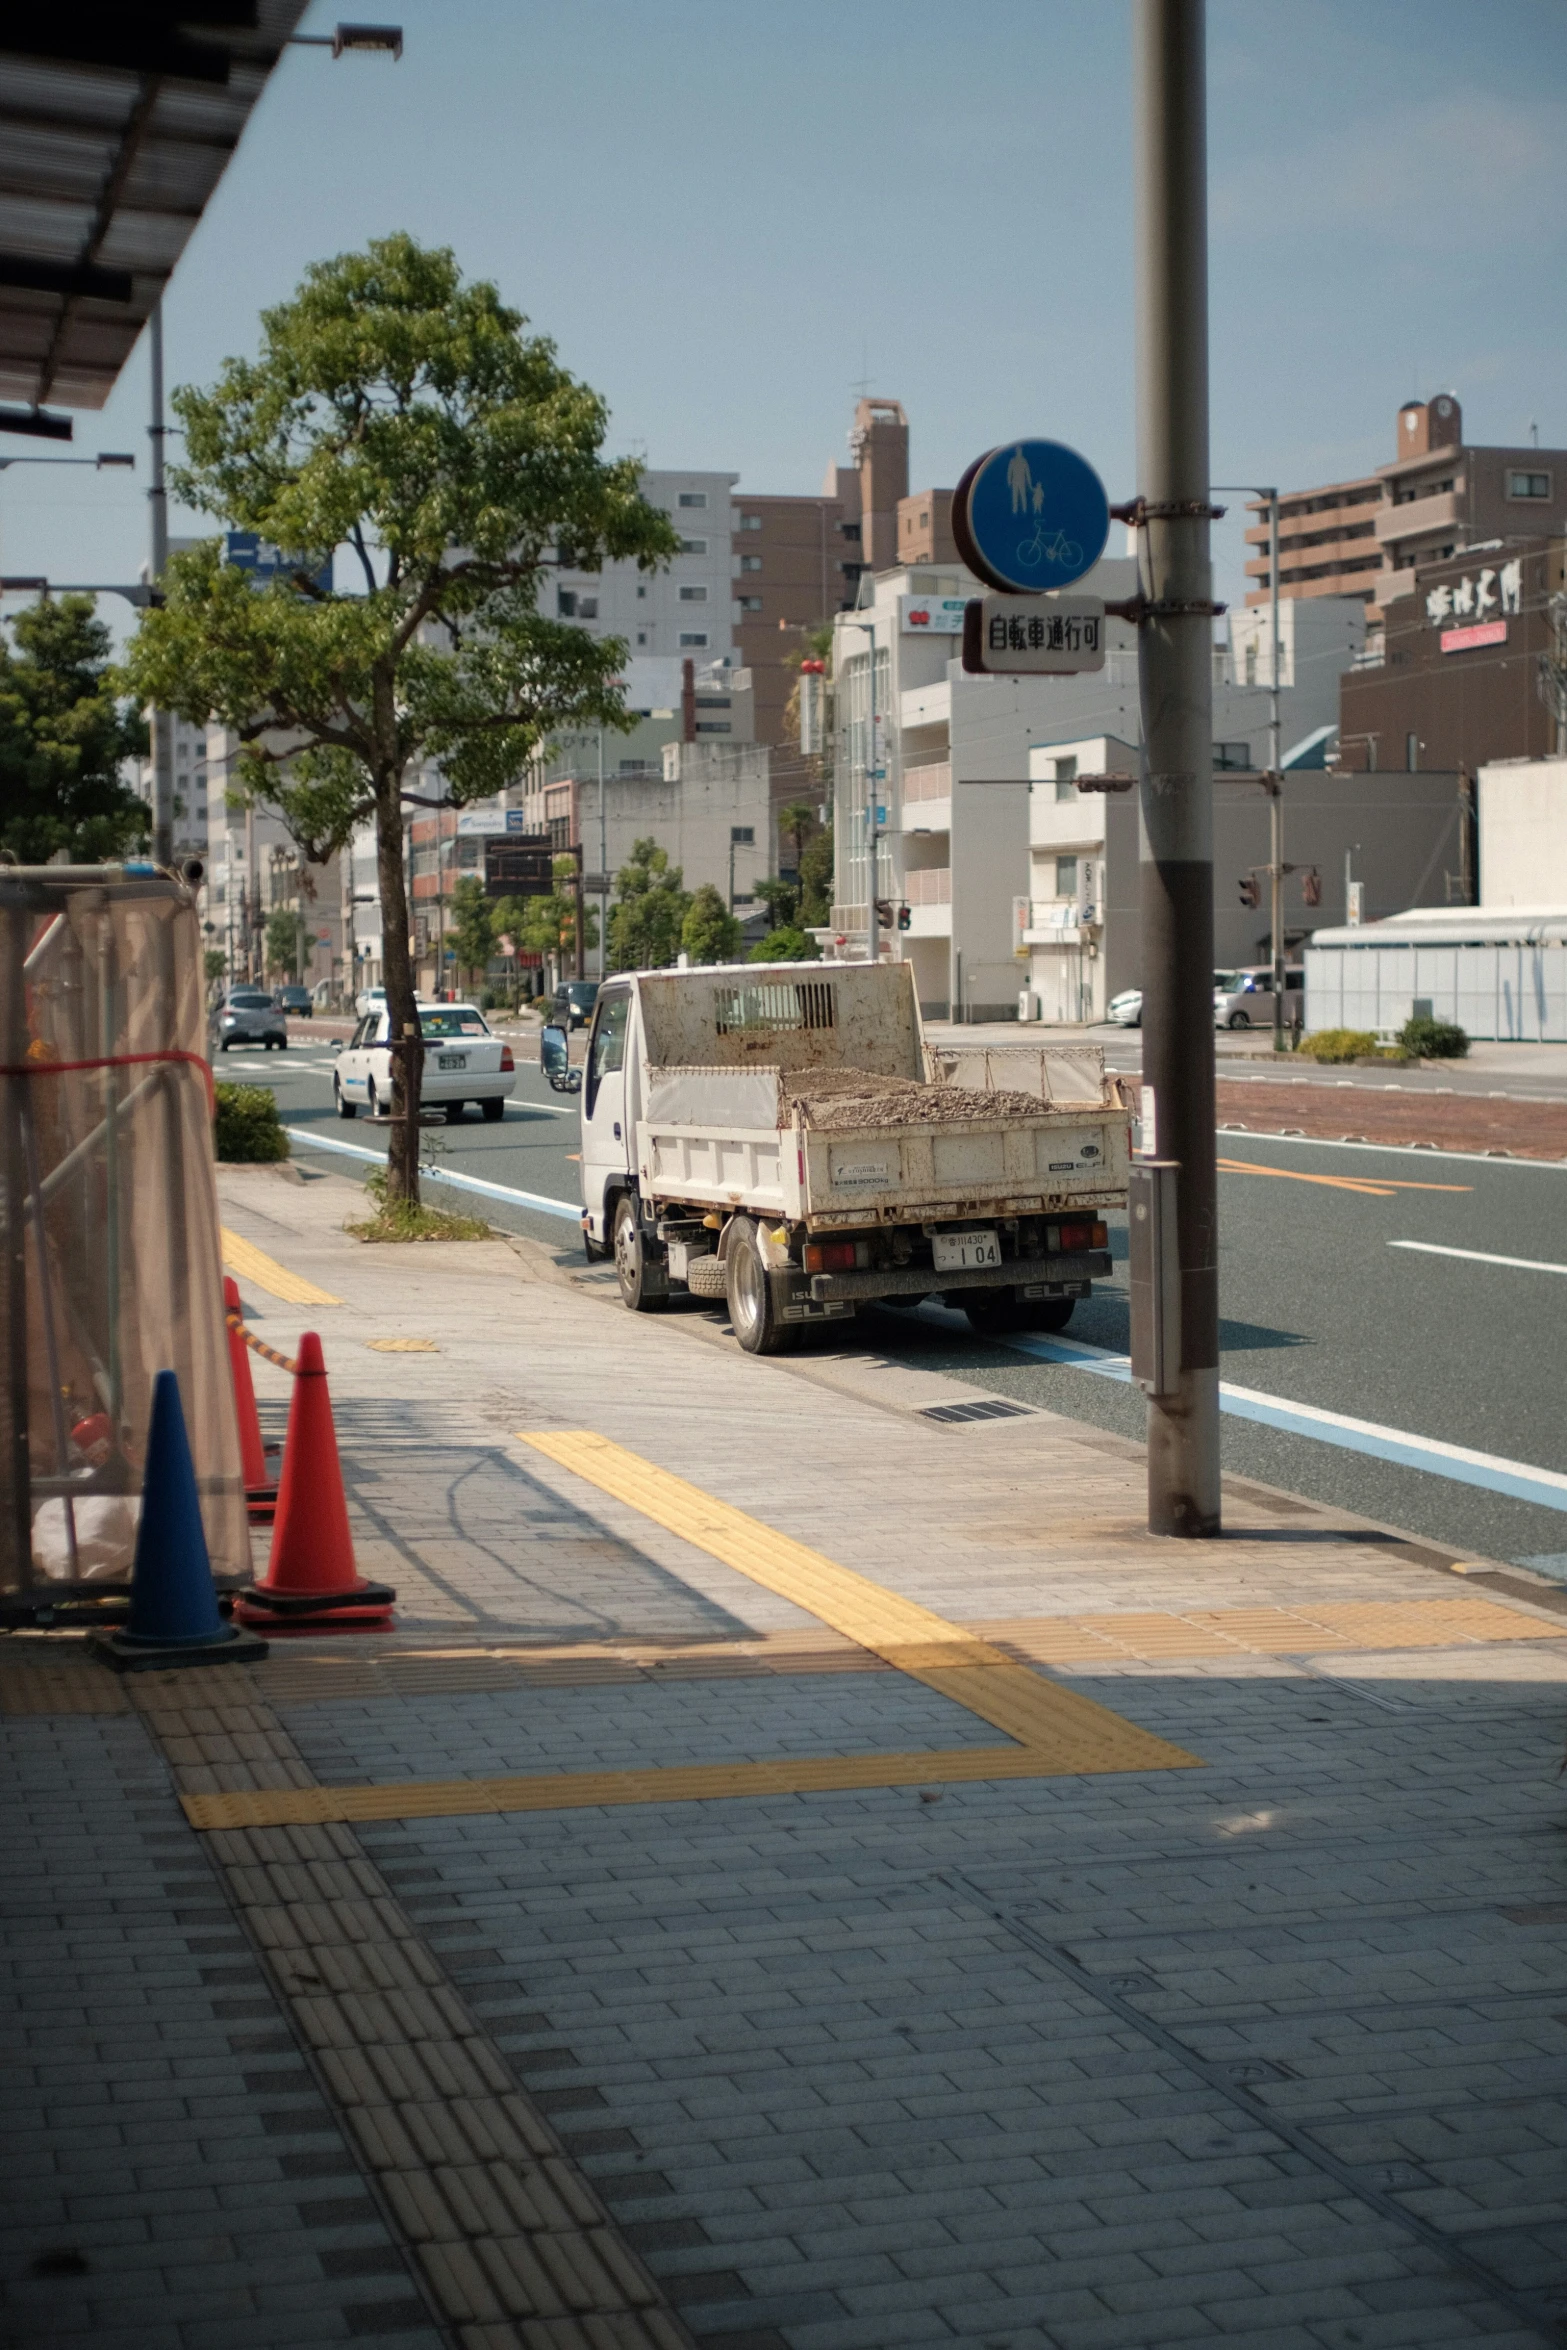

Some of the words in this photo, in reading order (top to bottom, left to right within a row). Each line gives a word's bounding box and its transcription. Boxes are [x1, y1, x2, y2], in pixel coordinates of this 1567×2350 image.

[989, 613, 1101, 652] 自転車通行可
[1076, 1161, 1101, 1169] ELF
[1023, 1282, 1083, 1299] ELF
[782, 1301, 844, 1319] ELF
